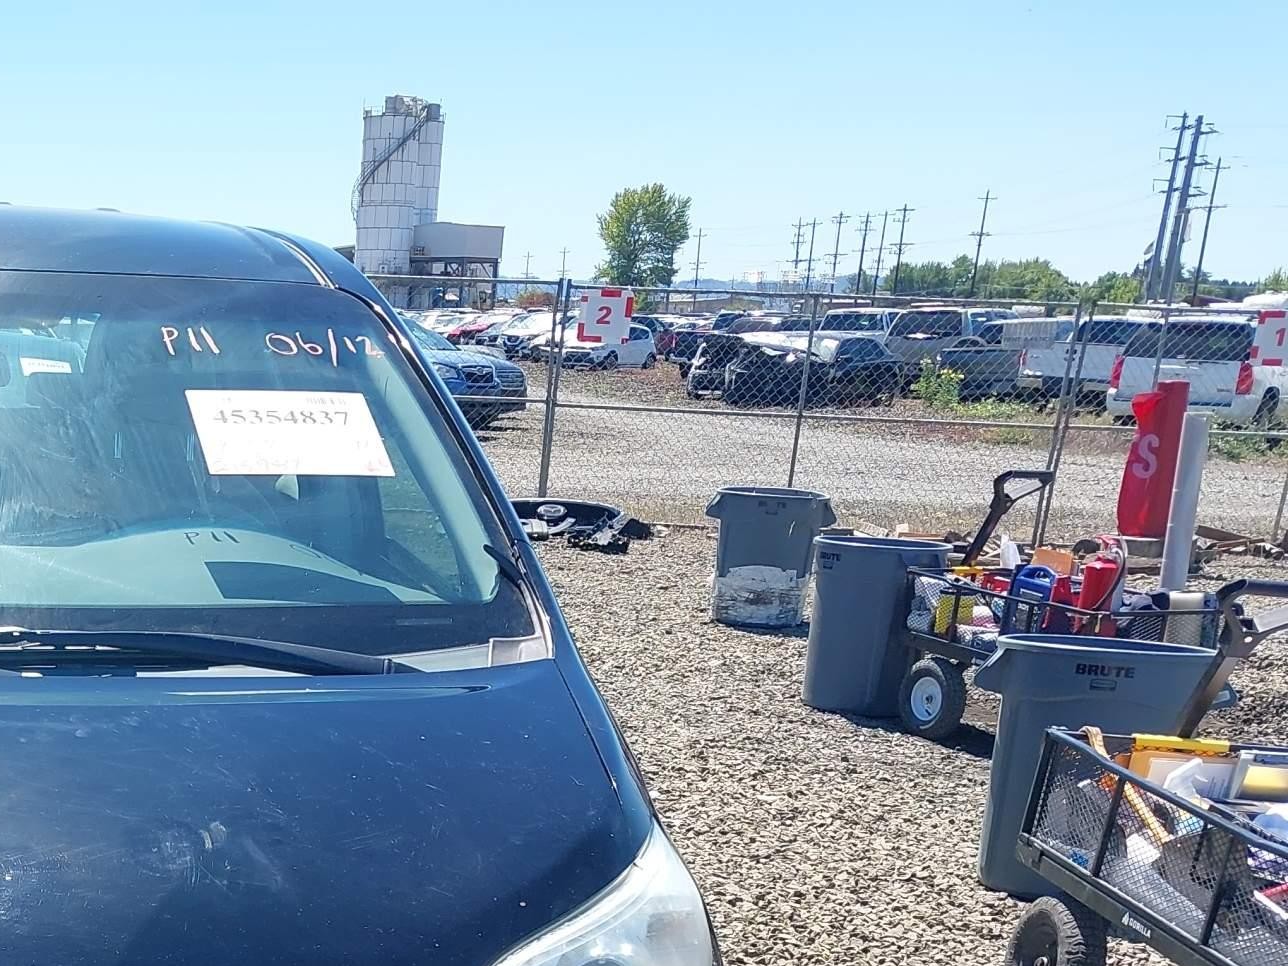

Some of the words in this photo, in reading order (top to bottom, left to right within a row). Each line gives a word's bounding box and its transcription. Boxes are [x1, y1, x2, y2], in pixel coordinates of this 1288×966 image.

[596, 306, 612, 324] 2
[1275, 327, 1287, 346] 1
[266, 328, 385, 368] 06/12
[213, 408, 349, 426] 45354837
[1131, 433, 1160, 479] S
[1075, 663, 1136, 679] BRUTE
